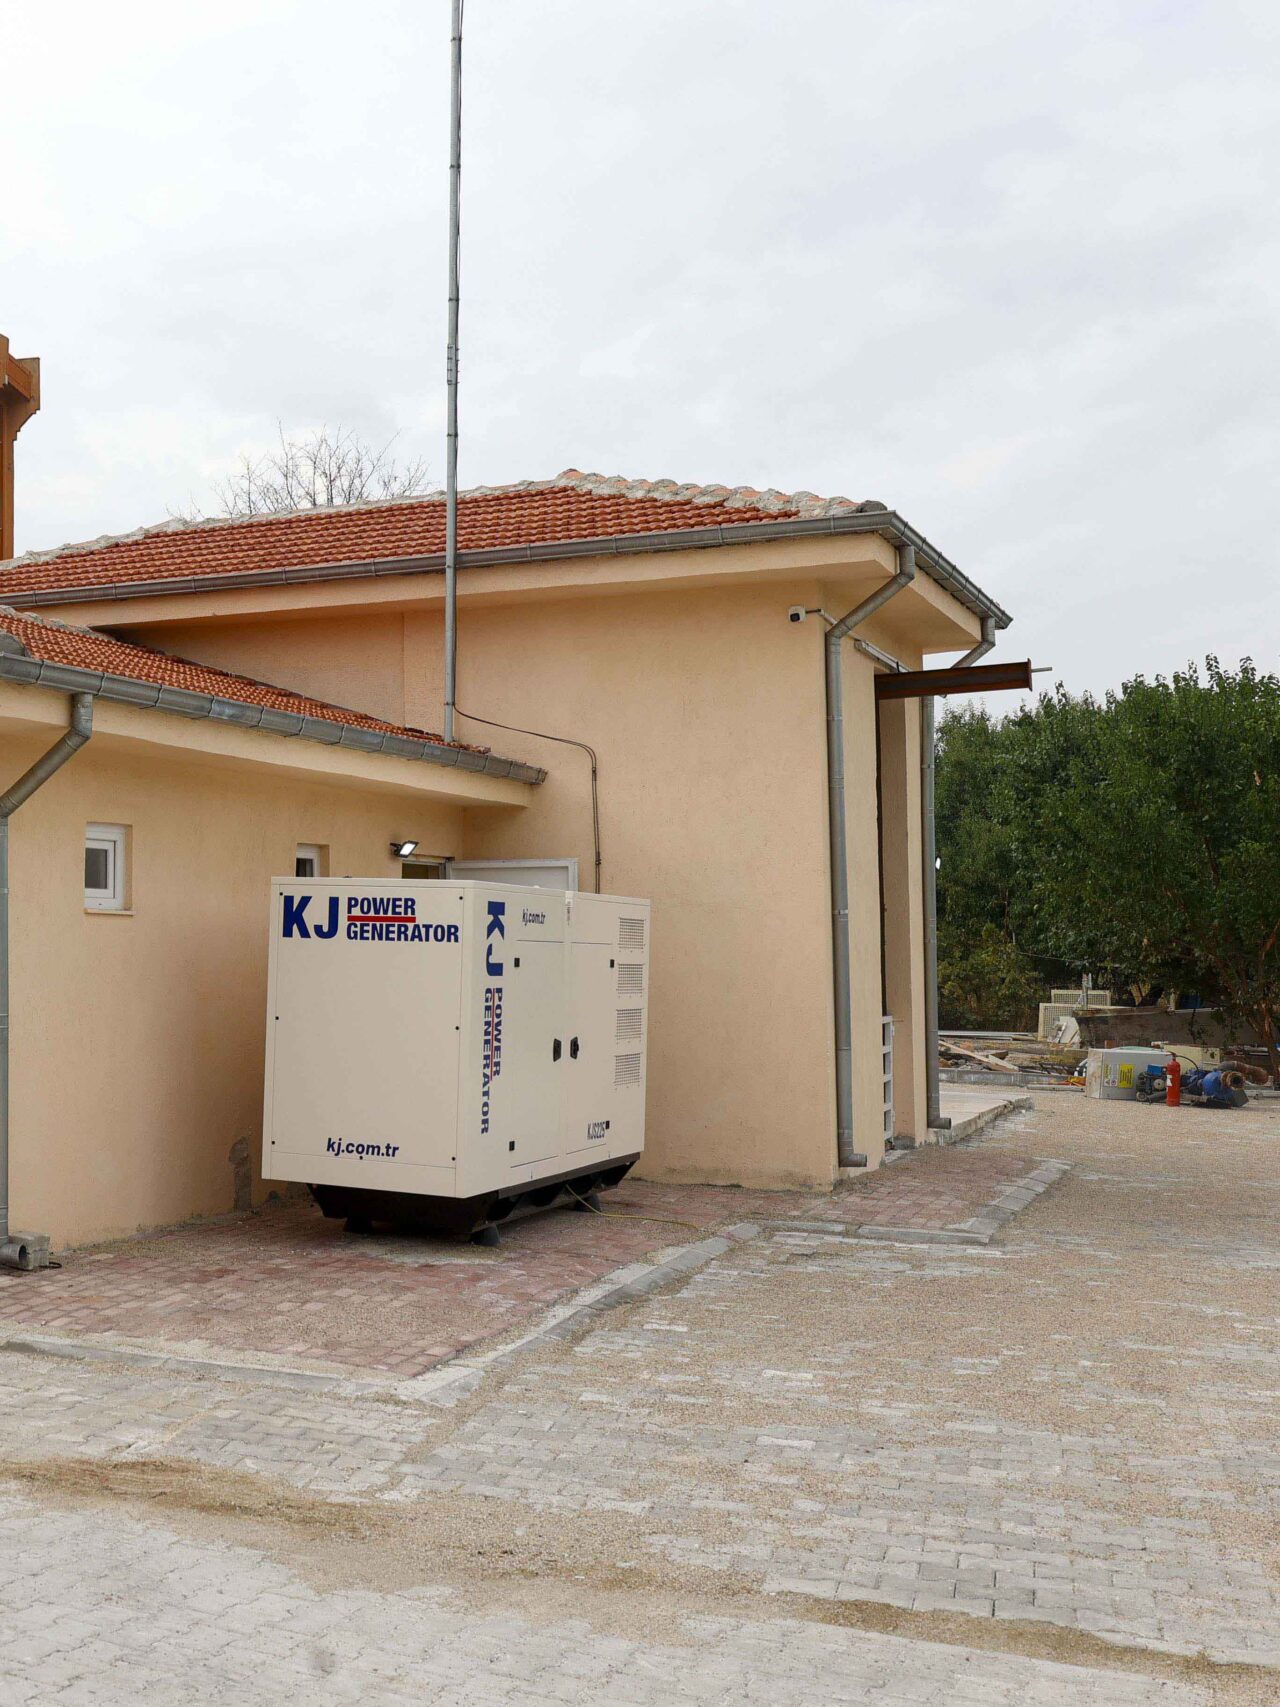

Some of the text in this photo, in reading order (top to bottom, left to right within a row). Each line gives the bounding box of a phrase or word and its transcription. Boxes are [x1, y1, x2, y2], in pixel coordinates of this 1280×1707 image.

[282, 895, 340, 939] KJ
[347, 897, 416, 915] POWER
[522, 908, 546, 926] kj.com.tr
[346, 922, 460, 943] GENERATOR
[485, 901, 506, 976] KJ
[492, 987, 503, 1077] POWER
[480, 988, 493, 1135] GENERATOR
[326, 1137, 400, 1157] kj.com.tr
